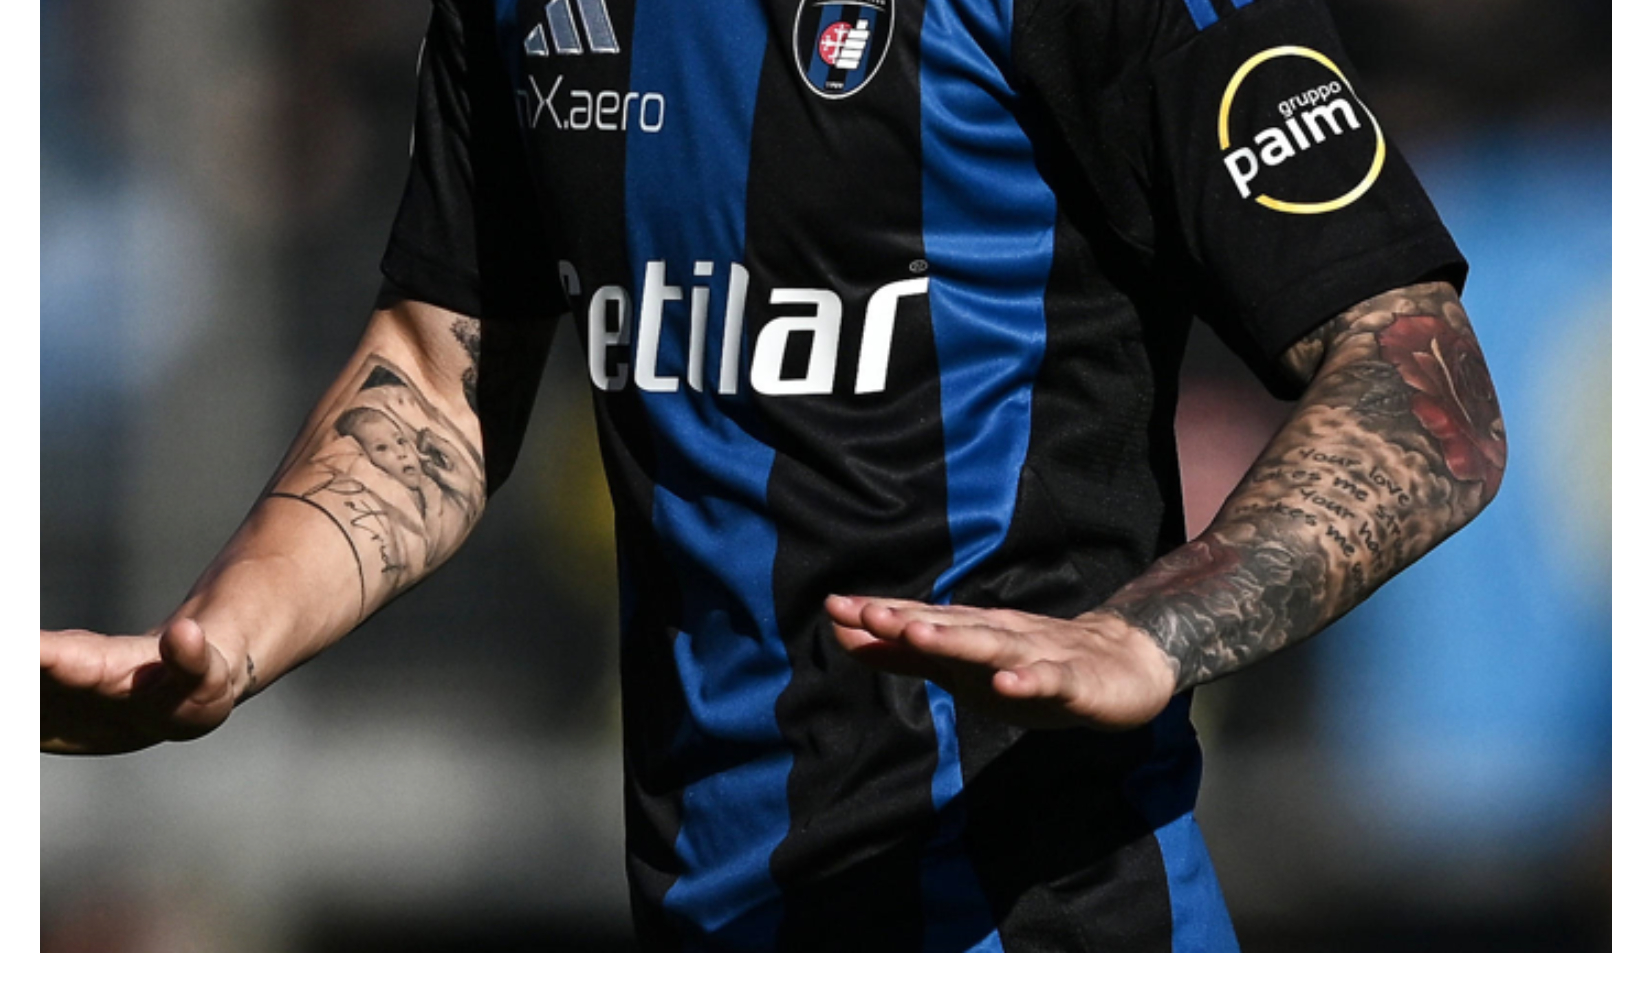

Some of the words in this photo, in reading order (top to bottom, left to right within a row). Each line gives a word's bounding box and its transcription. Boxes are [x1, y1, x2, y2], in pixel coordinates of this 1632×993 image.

[1278, 81, 1343, 118] gruppo
[1223, 97, 1361, 199] paim
[558, 259, 930, 395] etilar
[1333, 477, 1368, 502] me
[1325, 525, 1355, 557] me
